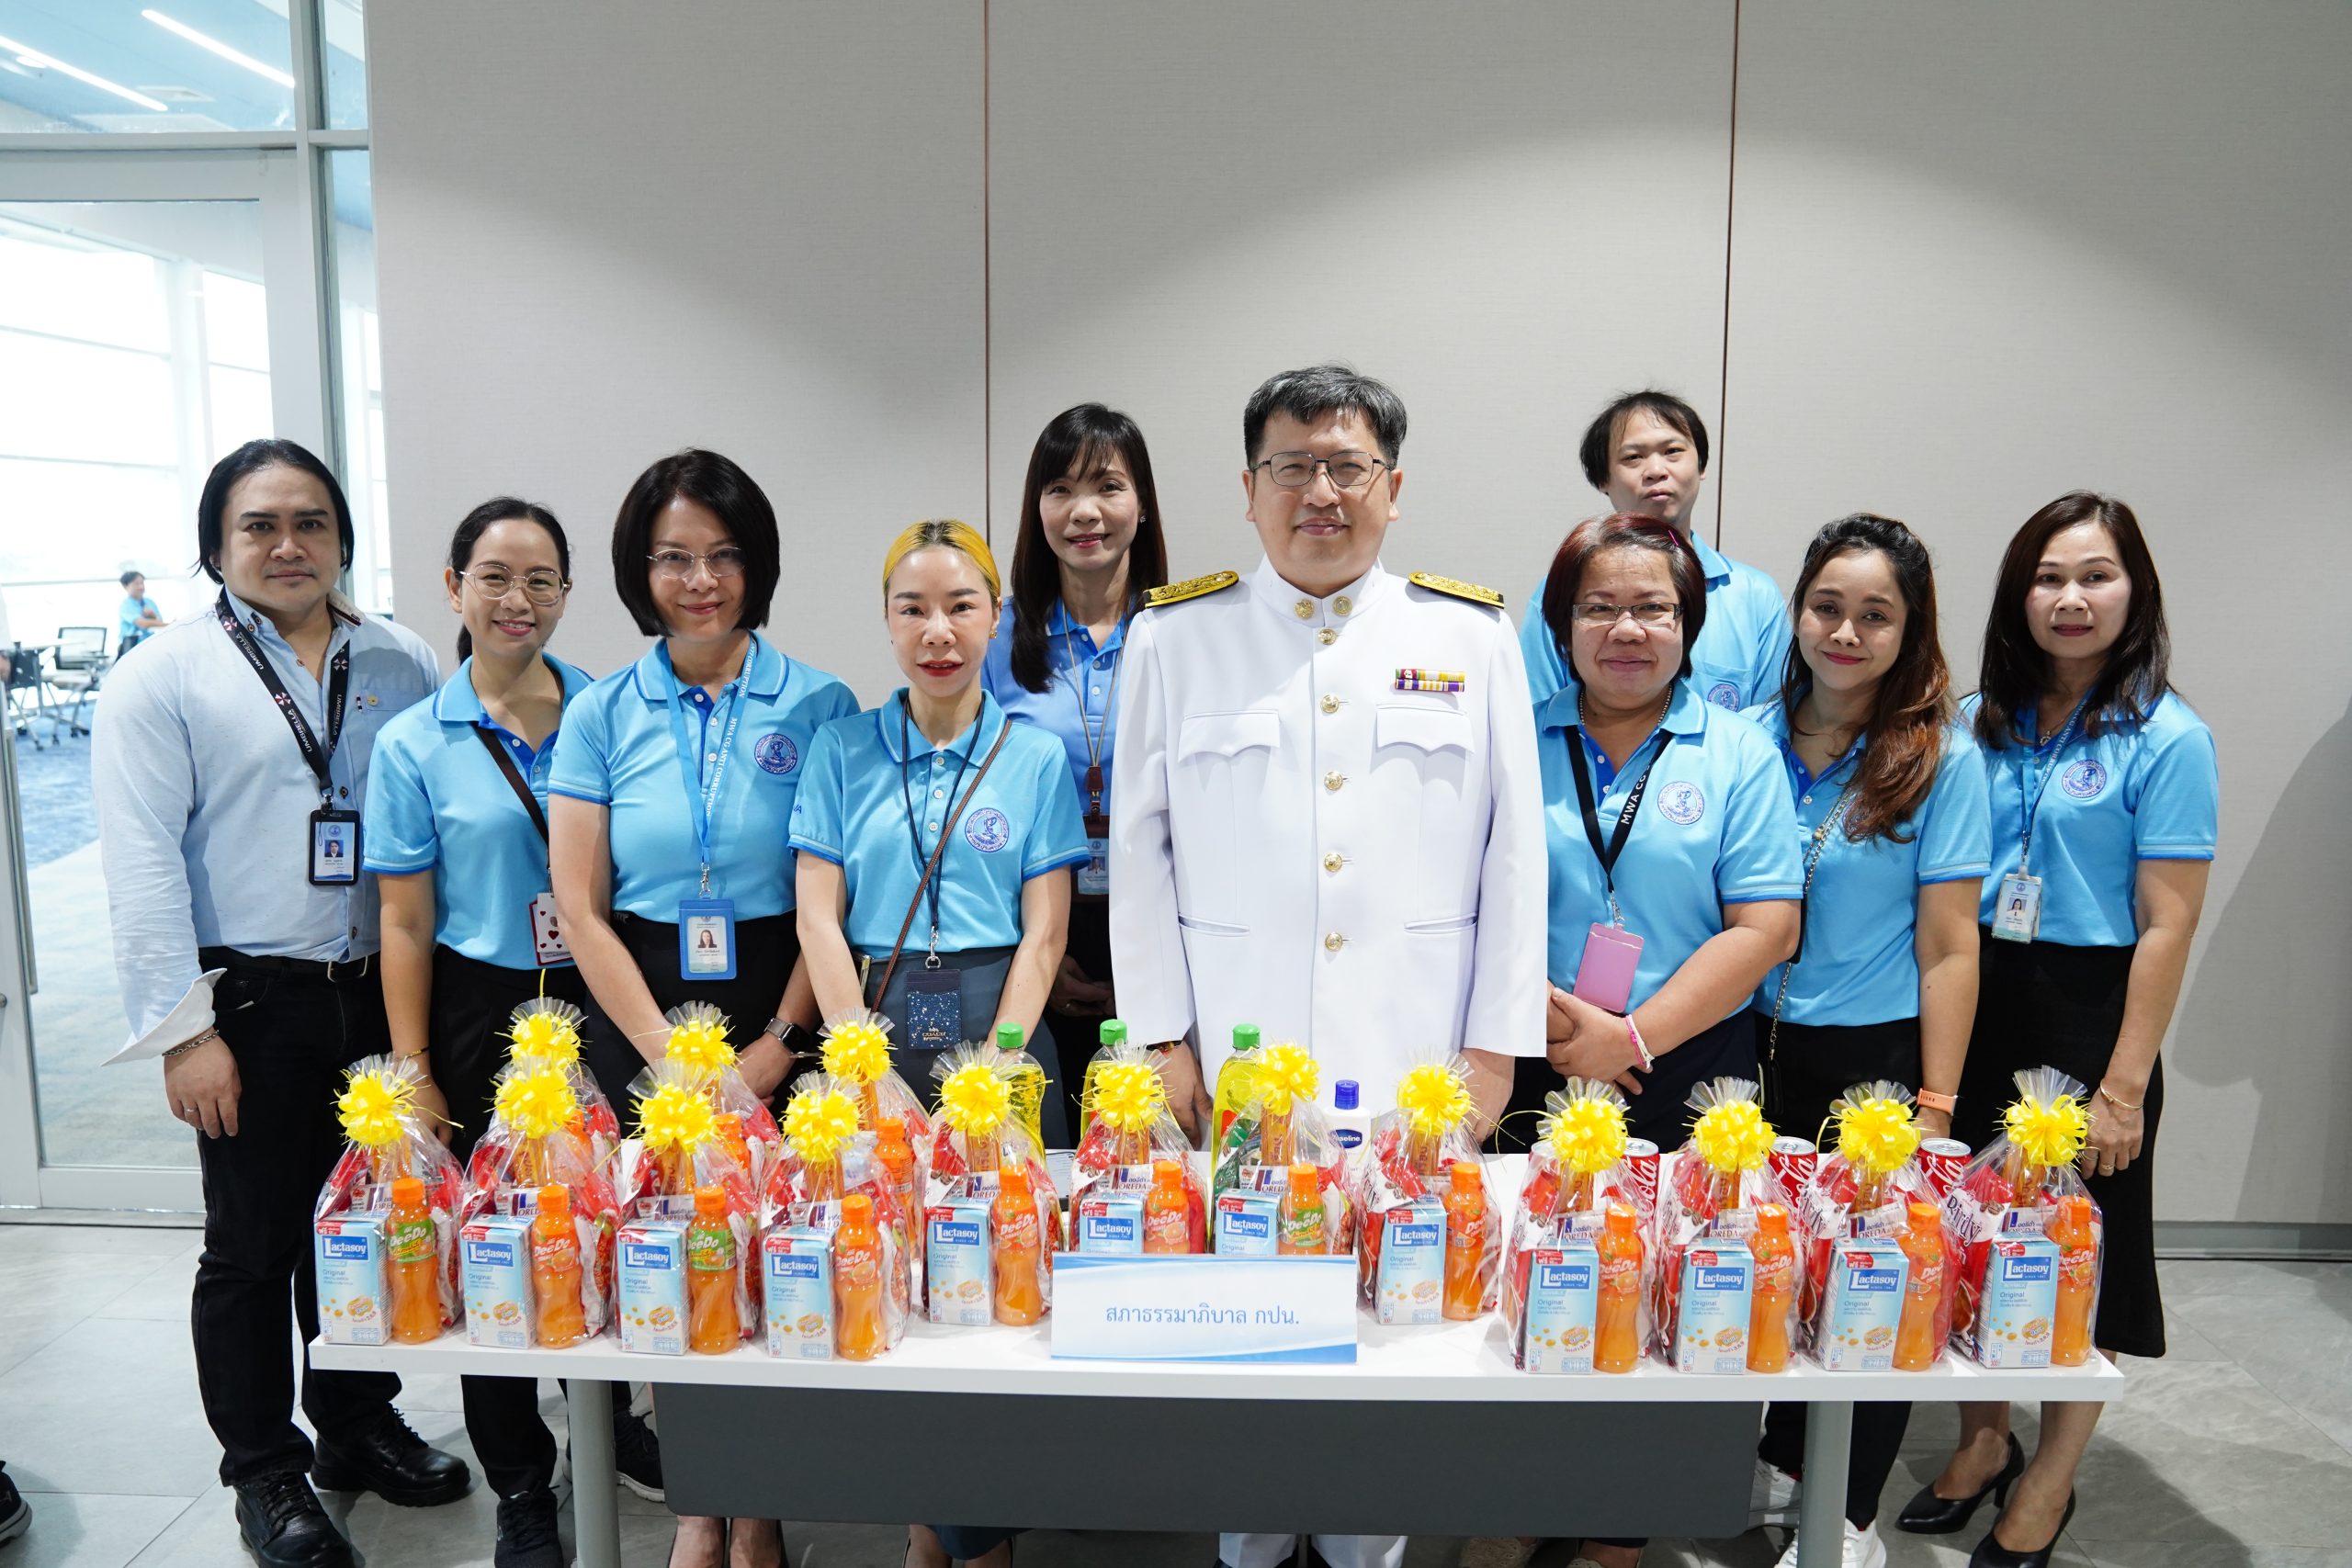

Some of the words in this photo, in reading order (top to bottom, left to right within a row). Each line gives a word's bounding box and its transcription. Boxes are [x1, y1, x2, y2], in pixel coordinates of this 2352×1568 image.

[1620, 794, 1640, 825] MWA
[1089, 1219, 1132, 1237] Lactasoy
[1148, 1212, 1182, 1226] DeeDo
[1226, 1214, 1267, 1234] Lactasoy
[390, 1227, 426, 1247] DeeDo
[936, 1224, 978, 1242] Lactasoy
[1394, 1226, 1437, 1245] Lactasoy
[323, 1237, 367, 1257] Lactasoy
[469, 1244, 512, 1262] Lactasoy
[627, 1247, 670, 1265] Lactasoy
[774, 1257, 818, 1275] Lactasoy
[2005, 1260, 2049, 1279] Lactasoy
[1543, 1268, 1588, 1286] Lactasoy
[1697, 1269, 1743, 1288] Lactasoy
[1850, 1271, 1896, 1289] Lactasoy
[1106, 1303, 1247, 1324] สภาธรรมาภิบาล
[1256, 1305, 1300, 1325] กปน.
